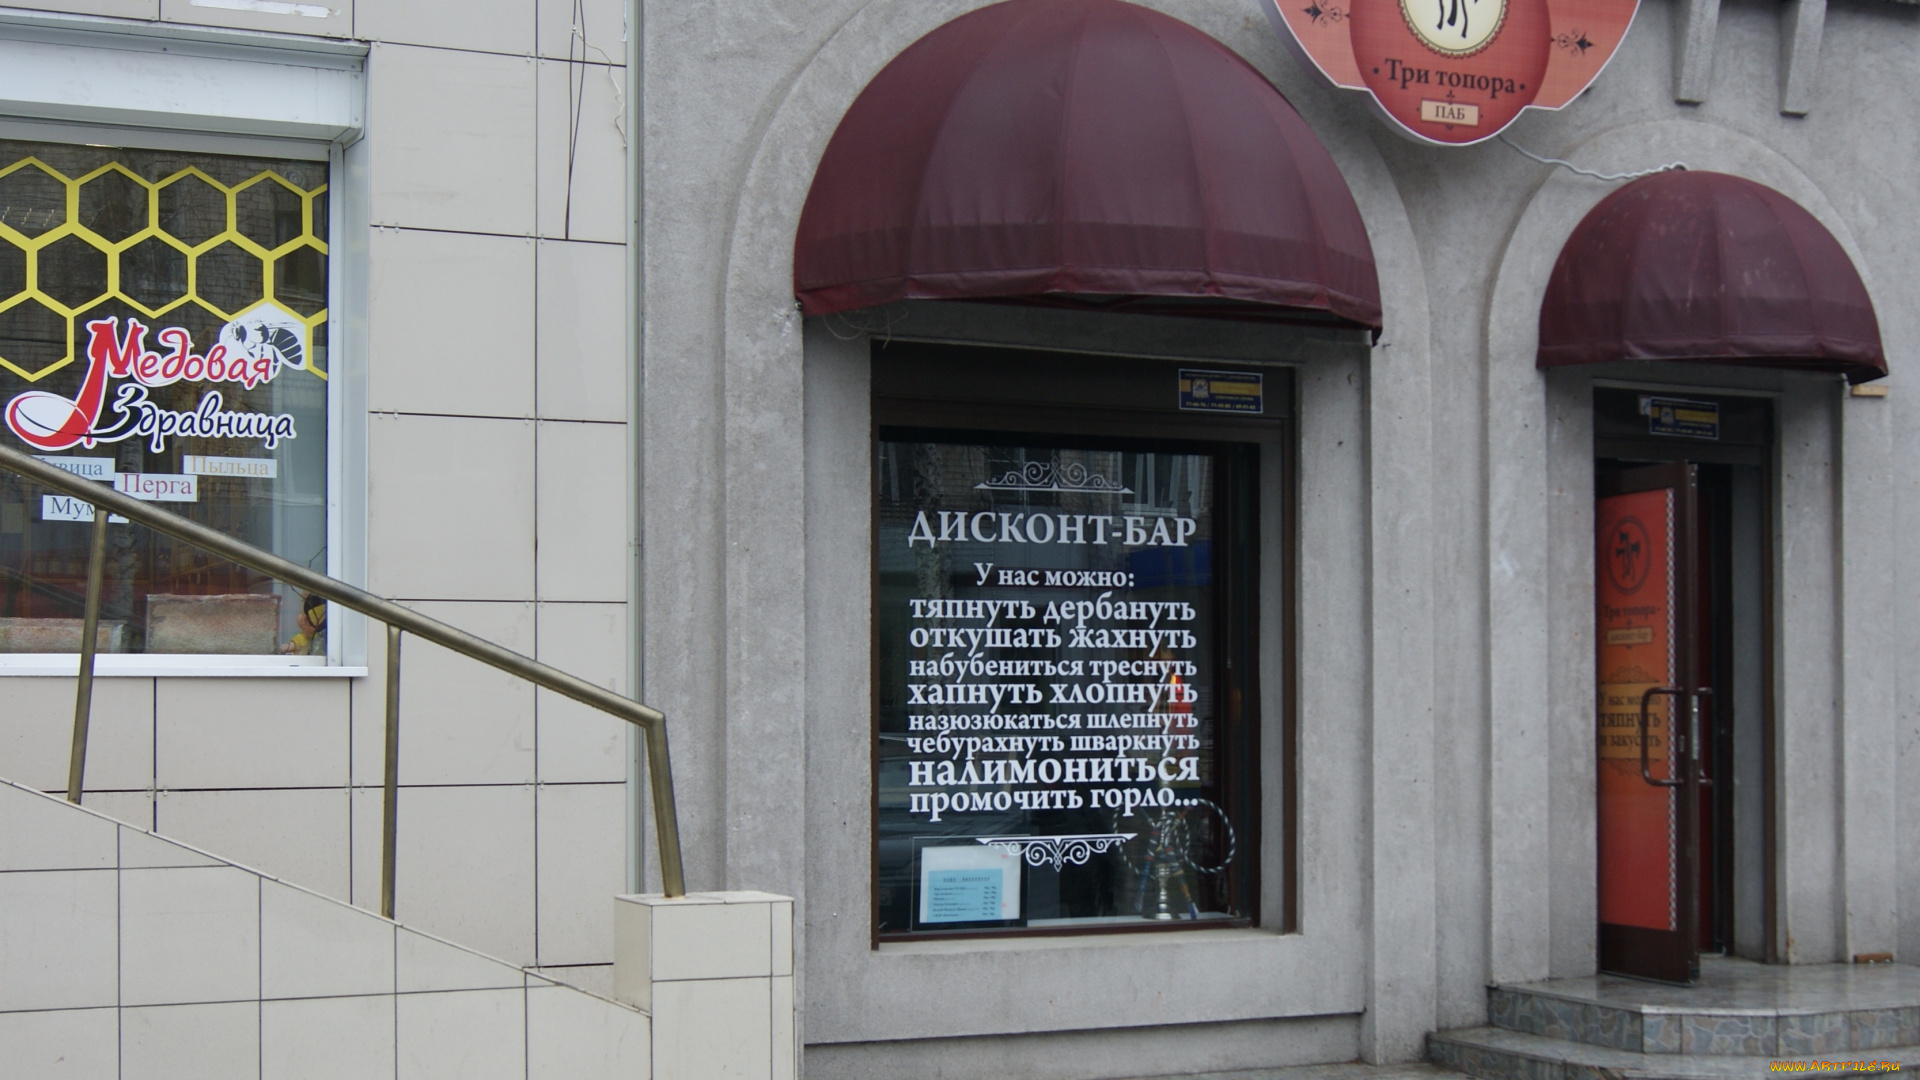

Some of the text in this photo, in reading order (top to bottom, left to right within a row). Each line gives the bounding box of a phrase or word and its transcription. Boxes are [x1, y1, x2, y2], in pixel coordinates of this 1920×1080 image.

[1384, 57, 1516, 99] Три топора
[1434, 105, 1466, 121] ПАБ
[87, 319, 275, 389] Медовая
[91, 386, 294, 451] Здравница
[190, 456, 270, 476] Пыльца
[122, 473, 193, 496] Перга
[907, 510, 1198, 549] ДИСКОНТ-БАР
[973, 562, 1136, 588] У нас можно:
[909, 590, 1197, 630] тяпнуть дербануть
[909, 626, 1198, 658] откушать жахнуть
[909, 651, 1198, 684] набубениться треснуть
[907, 682, 1199, 714] хапнуть хлопнуть
[908, 712, 1199, 735] назюзюкаться шлепнуть
[906, 729, 1201, 760] чебурахнуть шваркнуть
[908, 757, 1200, 787] налимониться
[909, 787, 1199, 823] промочить горло...
